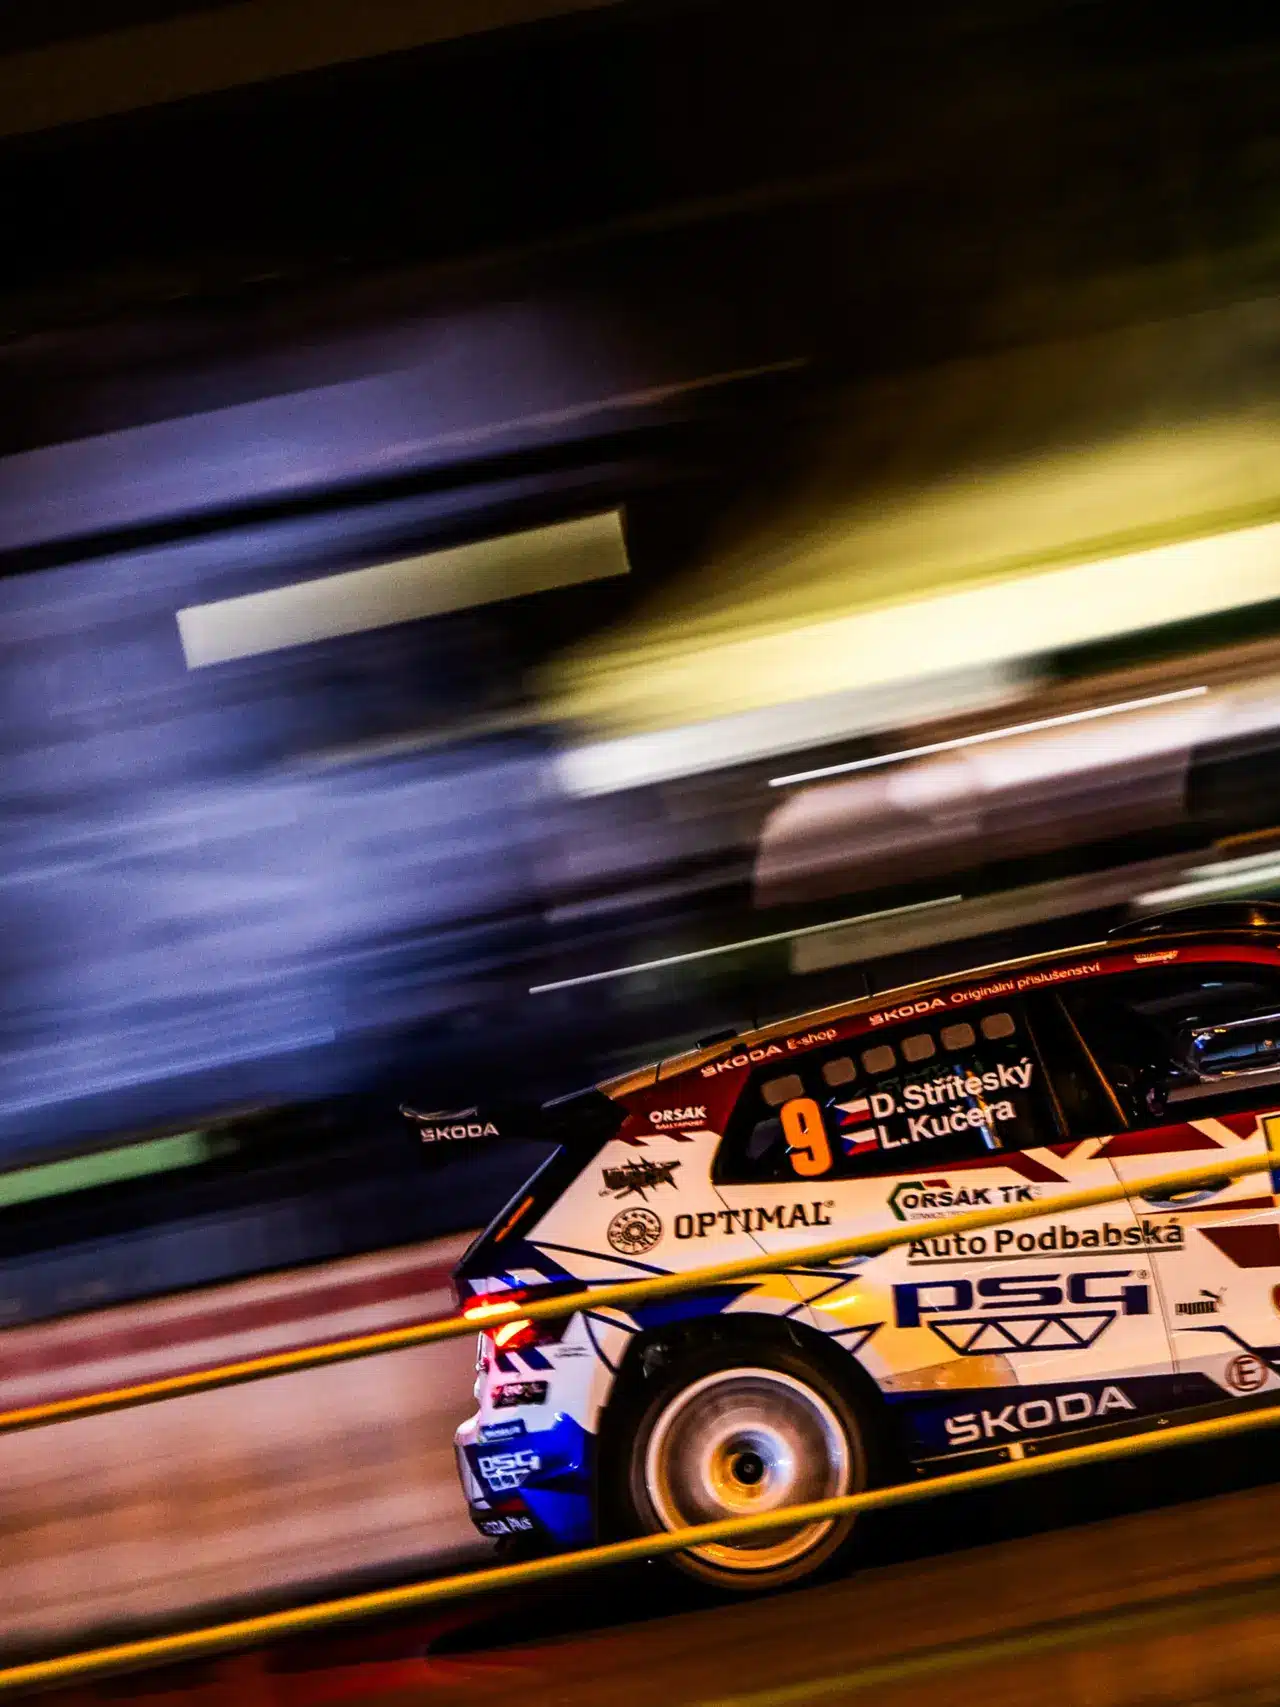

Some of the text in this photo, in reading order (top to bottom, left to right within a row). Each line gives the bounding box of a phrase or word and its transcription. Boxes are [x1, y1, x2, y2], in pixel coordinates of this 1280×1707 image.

[786, 1026, 838, 1052] E-shop
[780, 1097, 834, 1178] 9
[906, 1217, 1185, 1258] Auto Podbabská
